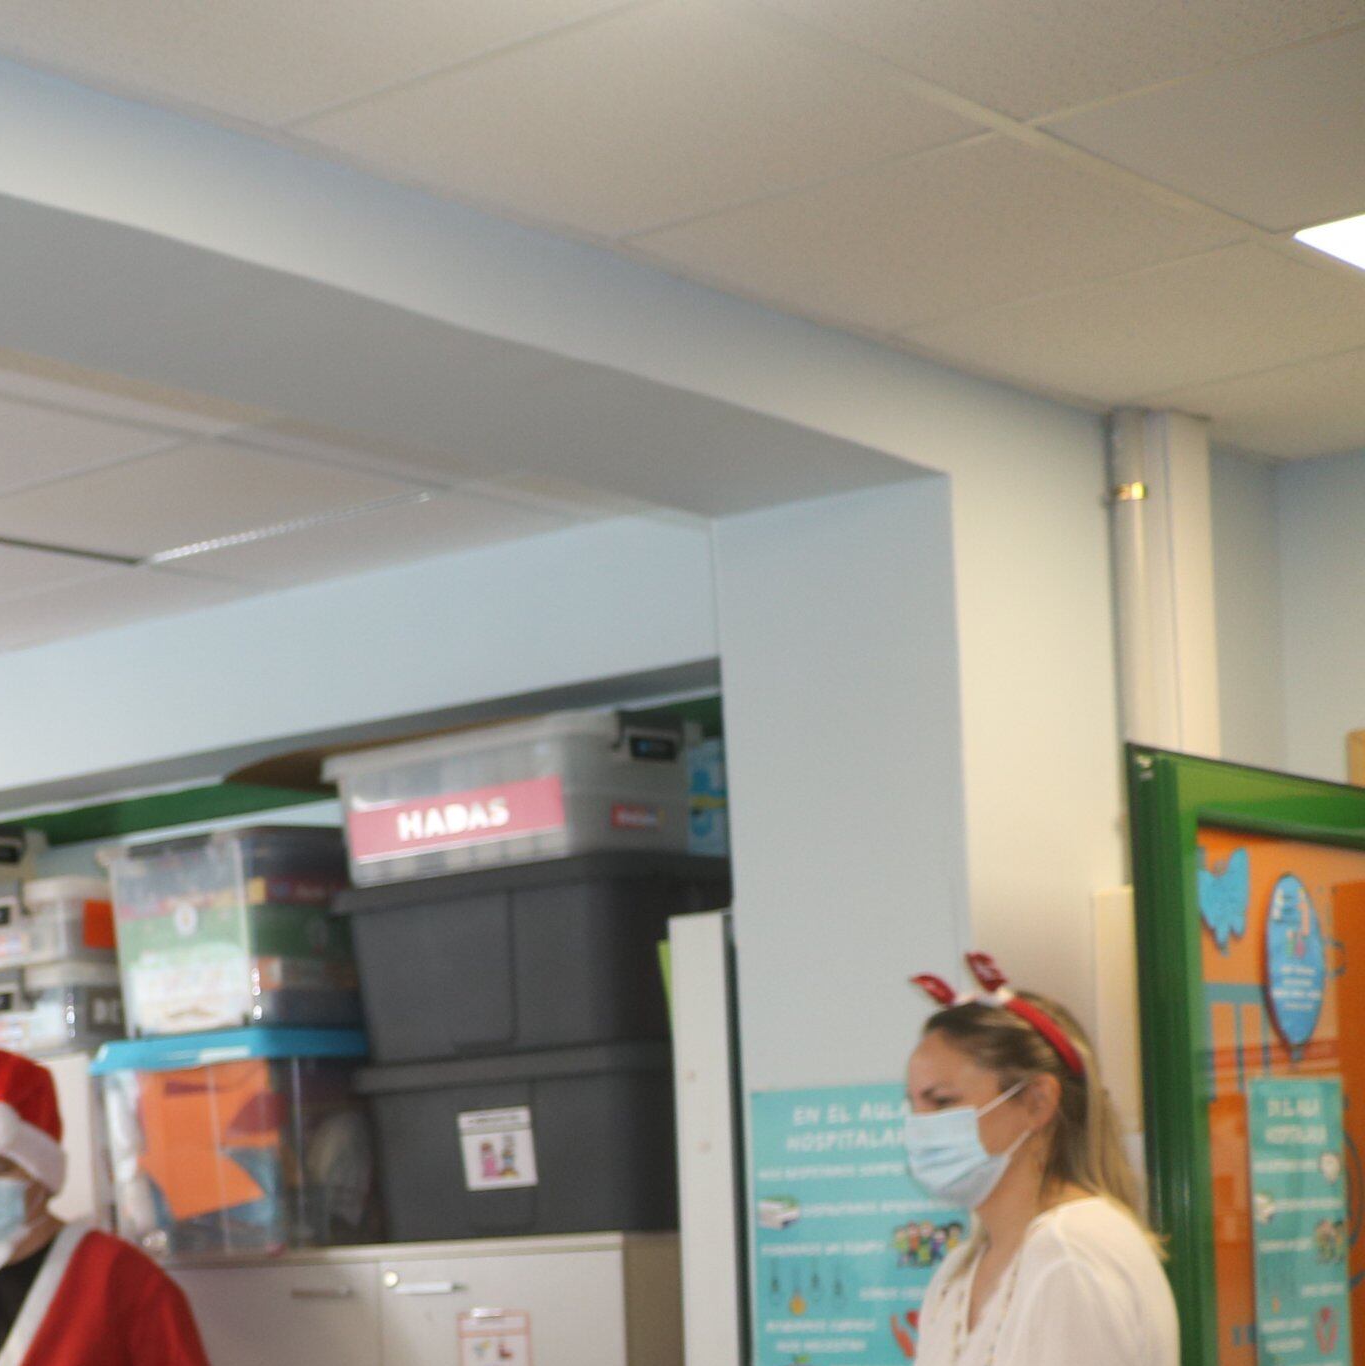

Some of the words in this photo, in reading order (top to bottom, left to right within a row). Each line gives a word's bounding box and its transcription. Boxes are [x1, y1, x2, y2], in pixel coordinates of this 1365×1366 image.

[396, 798, 510, 841] HADAS
[792, 1105, 821, 1127] EN
[826, 1103, 851, 1124] EL
